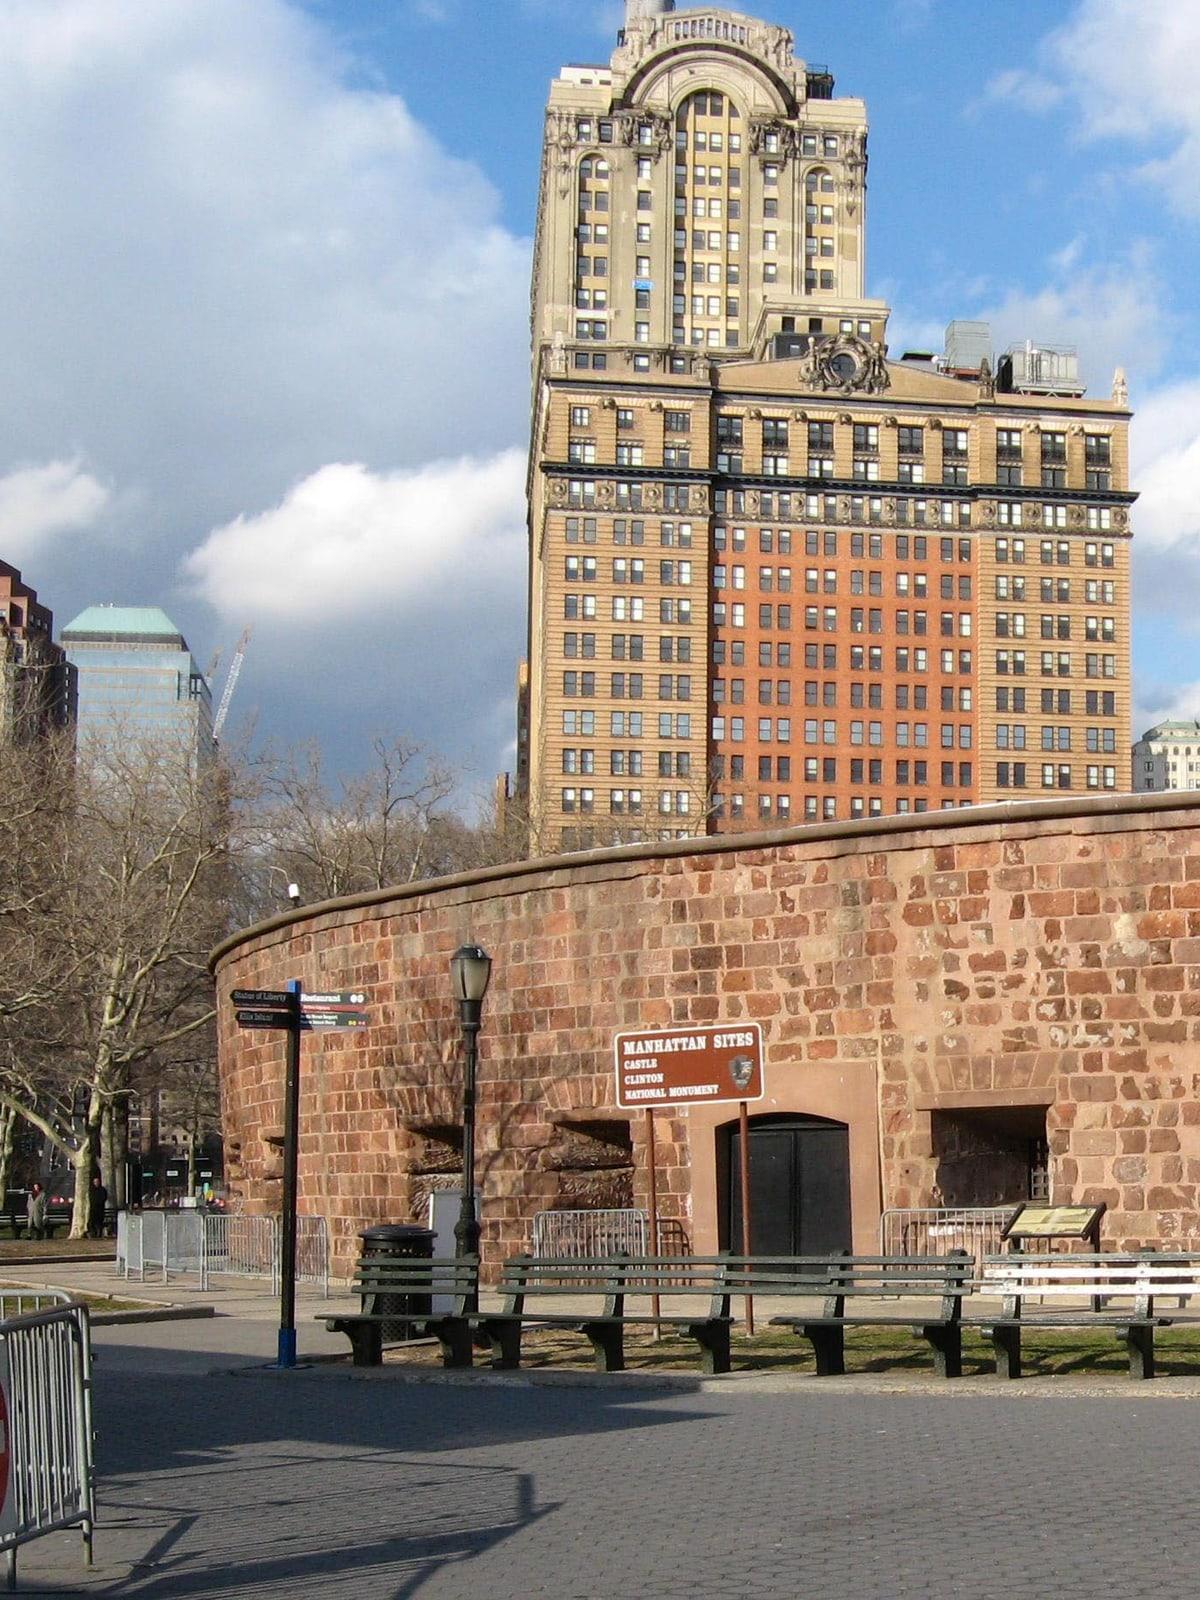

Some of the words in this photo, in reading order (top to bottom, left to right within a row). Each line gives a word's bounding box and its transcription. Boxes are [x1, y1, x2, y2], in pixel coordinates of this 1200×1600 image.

[263, 992, 287, 1002] Liberty
[623, 1036, 706, 1055] MANHATTAN
[713, 1032, 754, 1049] SITES
[624, 1058, 658, 1070] CASTLE
[624, 1073, 664, 1085] CLINTON
[625, 1088, 667, 1100] NATIONAL
[669, 1084, 719, 1097] MONUMENT
